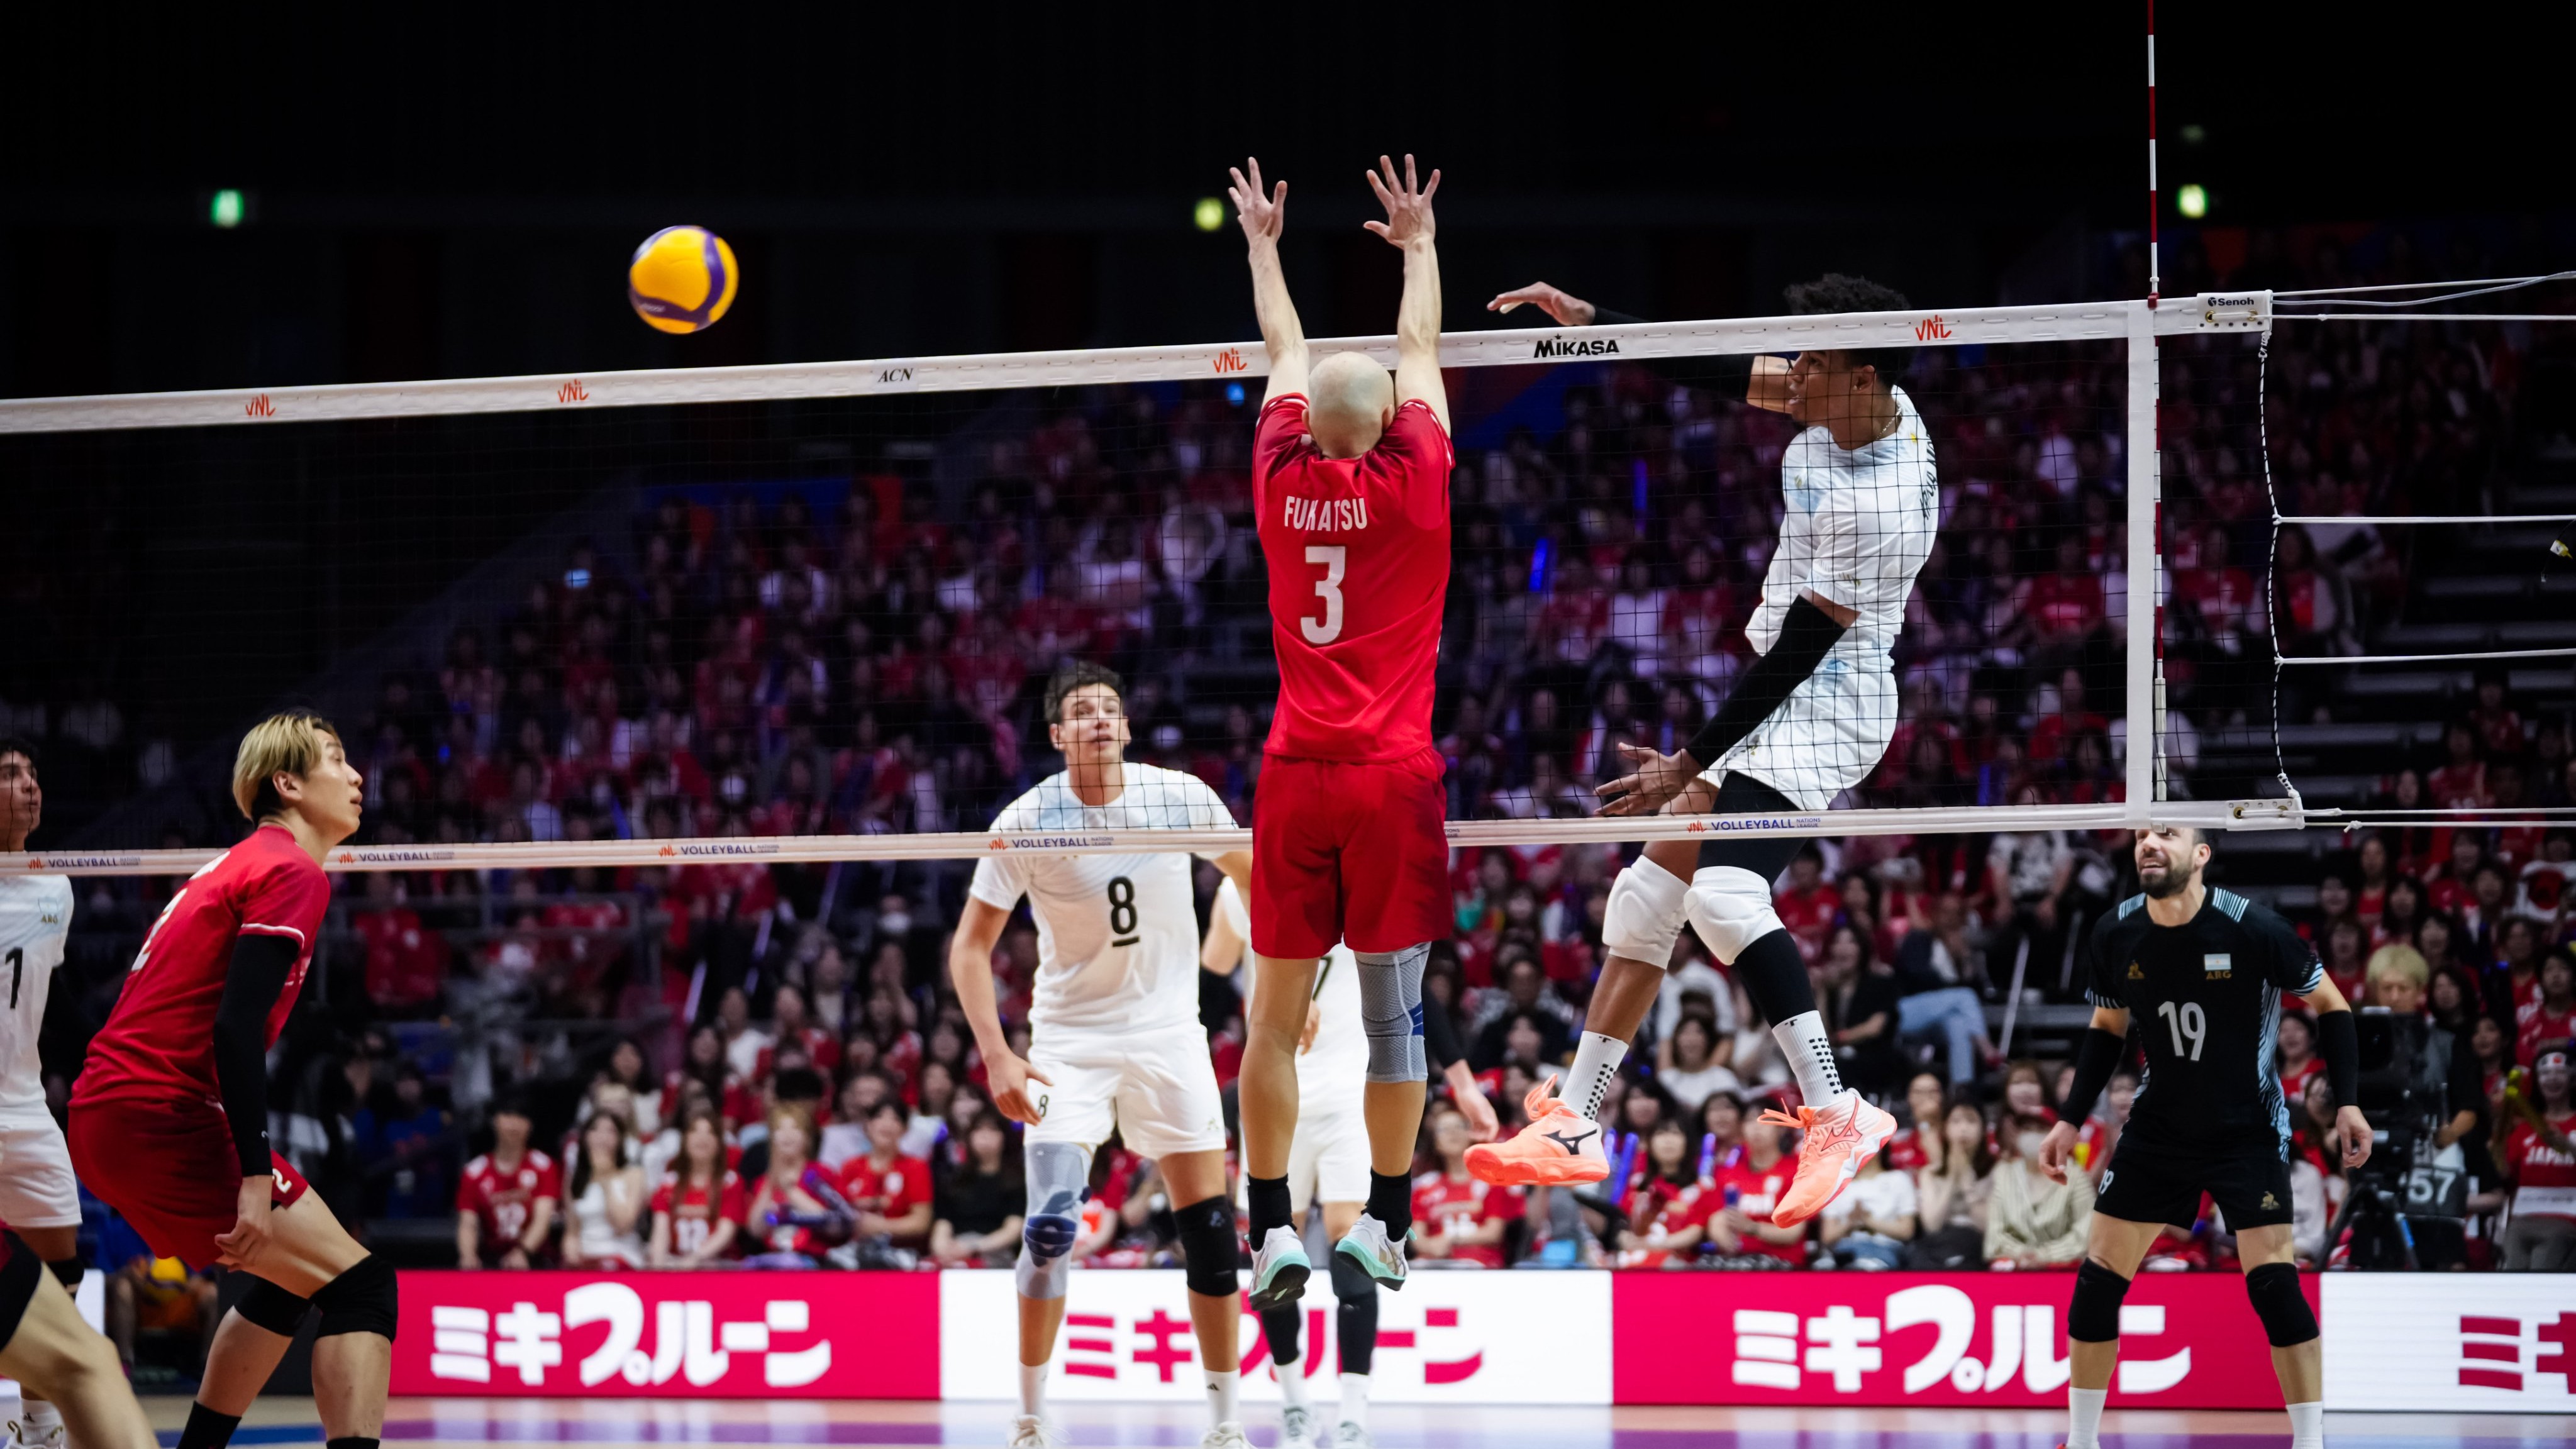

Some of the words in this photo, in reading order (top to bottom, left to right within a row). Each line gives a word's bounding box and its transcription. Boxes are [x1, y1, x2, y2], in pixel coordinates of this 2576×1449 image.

[2218, 297, 2255, 307] Senoh
[1915, 314, 1952, 341] VNL
[1533, 334, 1620, 358] MIKASA
[1213, 347, 1248, 374] VNL
[877, 367, 914, 383] ACN
[557, 379, 589, 402] VNL
[245, 393, 276, 416] VNL
[1284, 495, 1368, 532] FUKATSU
[1300, 545, 1346, 644] 3
[1686, 819, 1707, 833] VNL
[1711, 818, 1796, 830] VOLLEYBALL
[680, 845, 757, 855] VOLLEYBALL
[989, 837, 1009, 850] VNL
[1012, 837, 1091, 848] VOLLEYBALL
[48, 857, 119, 868] VOLLEYBALL
[359, 852, 433, 862] VOLLEYBALL
[1108, 875, 1138, 935] 8
[2206, 970, 2232, 980] ARG
[2158, 1001, 2206, 1062] 19
[1038, 1094, 1048, 1118] 8
[2407, 1167, 2457, 1206] 57
[430, 1282, 832, 1387] ミキプルーン
[1732, 1284, 2192, 1394] ミキプルン
